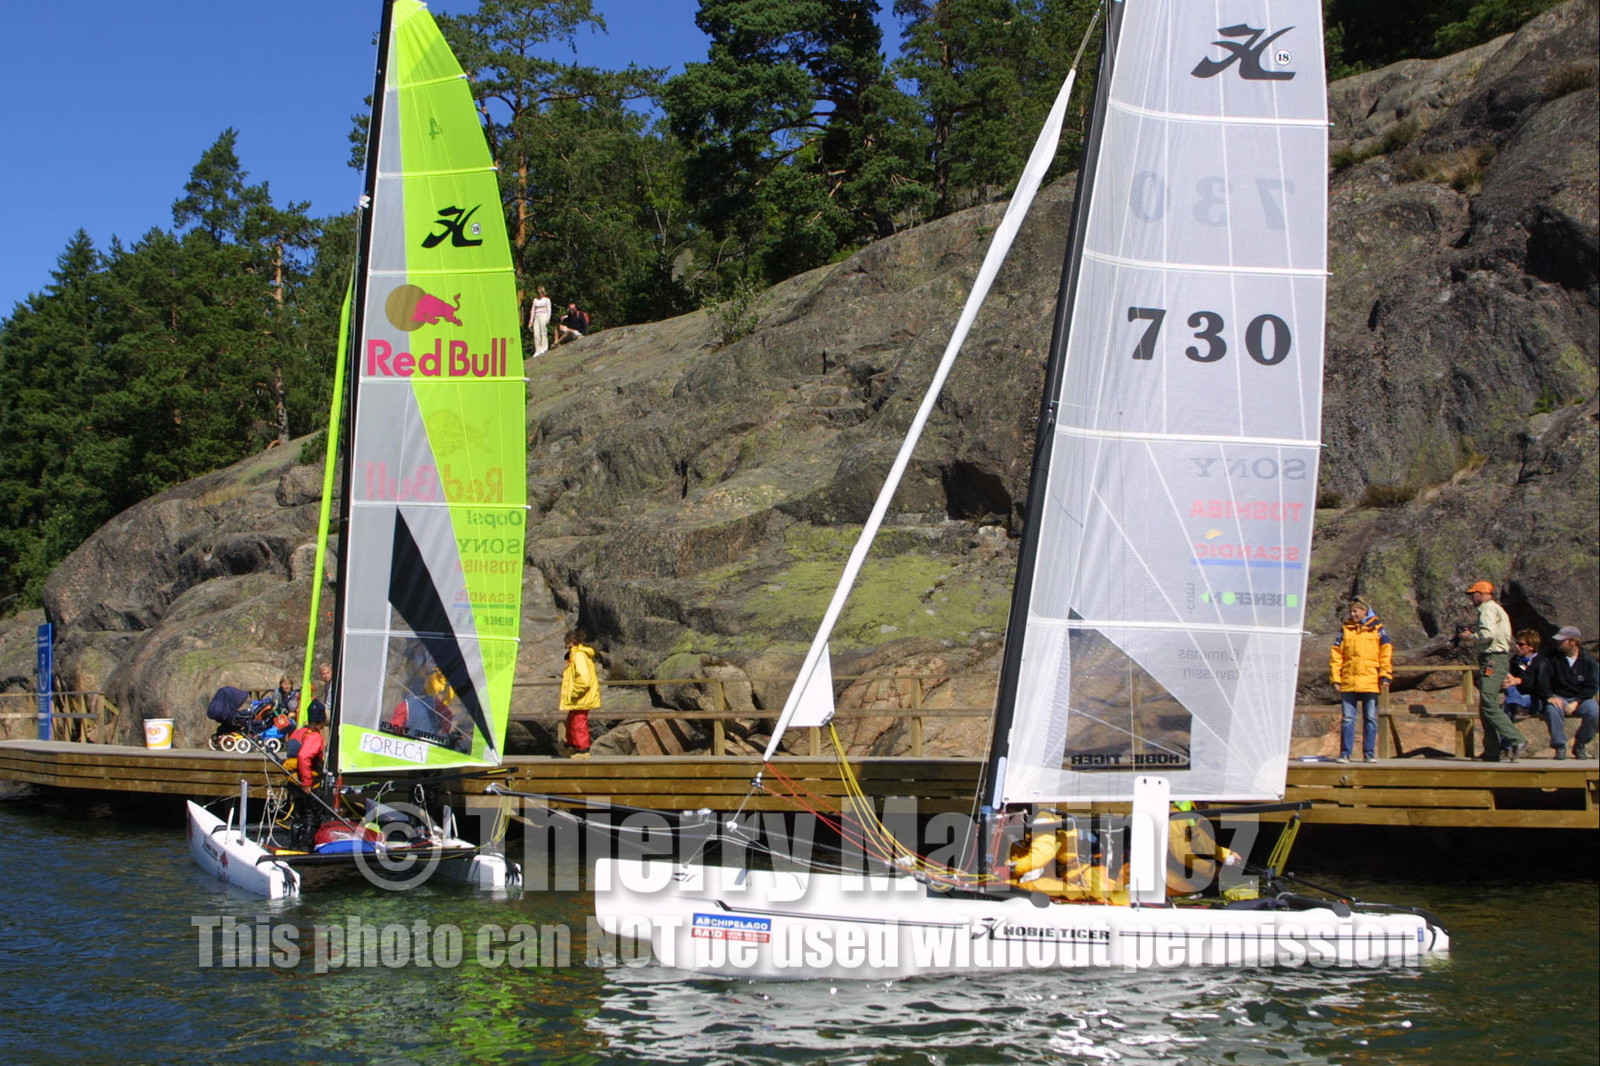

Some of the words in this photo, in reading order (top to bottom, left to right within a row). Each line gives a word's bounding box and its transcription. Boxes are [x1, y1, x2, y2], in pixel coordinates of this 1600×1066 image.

[1277, 53, 1289, 62] 18
[1127, 306, 1292, 366] 730
[367, 338, 441, 377] Red
[448, 337, 507, 377] Bull
[362, 734, 424, 761] FORECA
[695, 916, 769, 930] ARCHIPELAGO
[694, 928, 723, 938] RAID
[1003, 925, 1055, 938] HOBIE
[1059, 928, 1109, 940] TIGER
